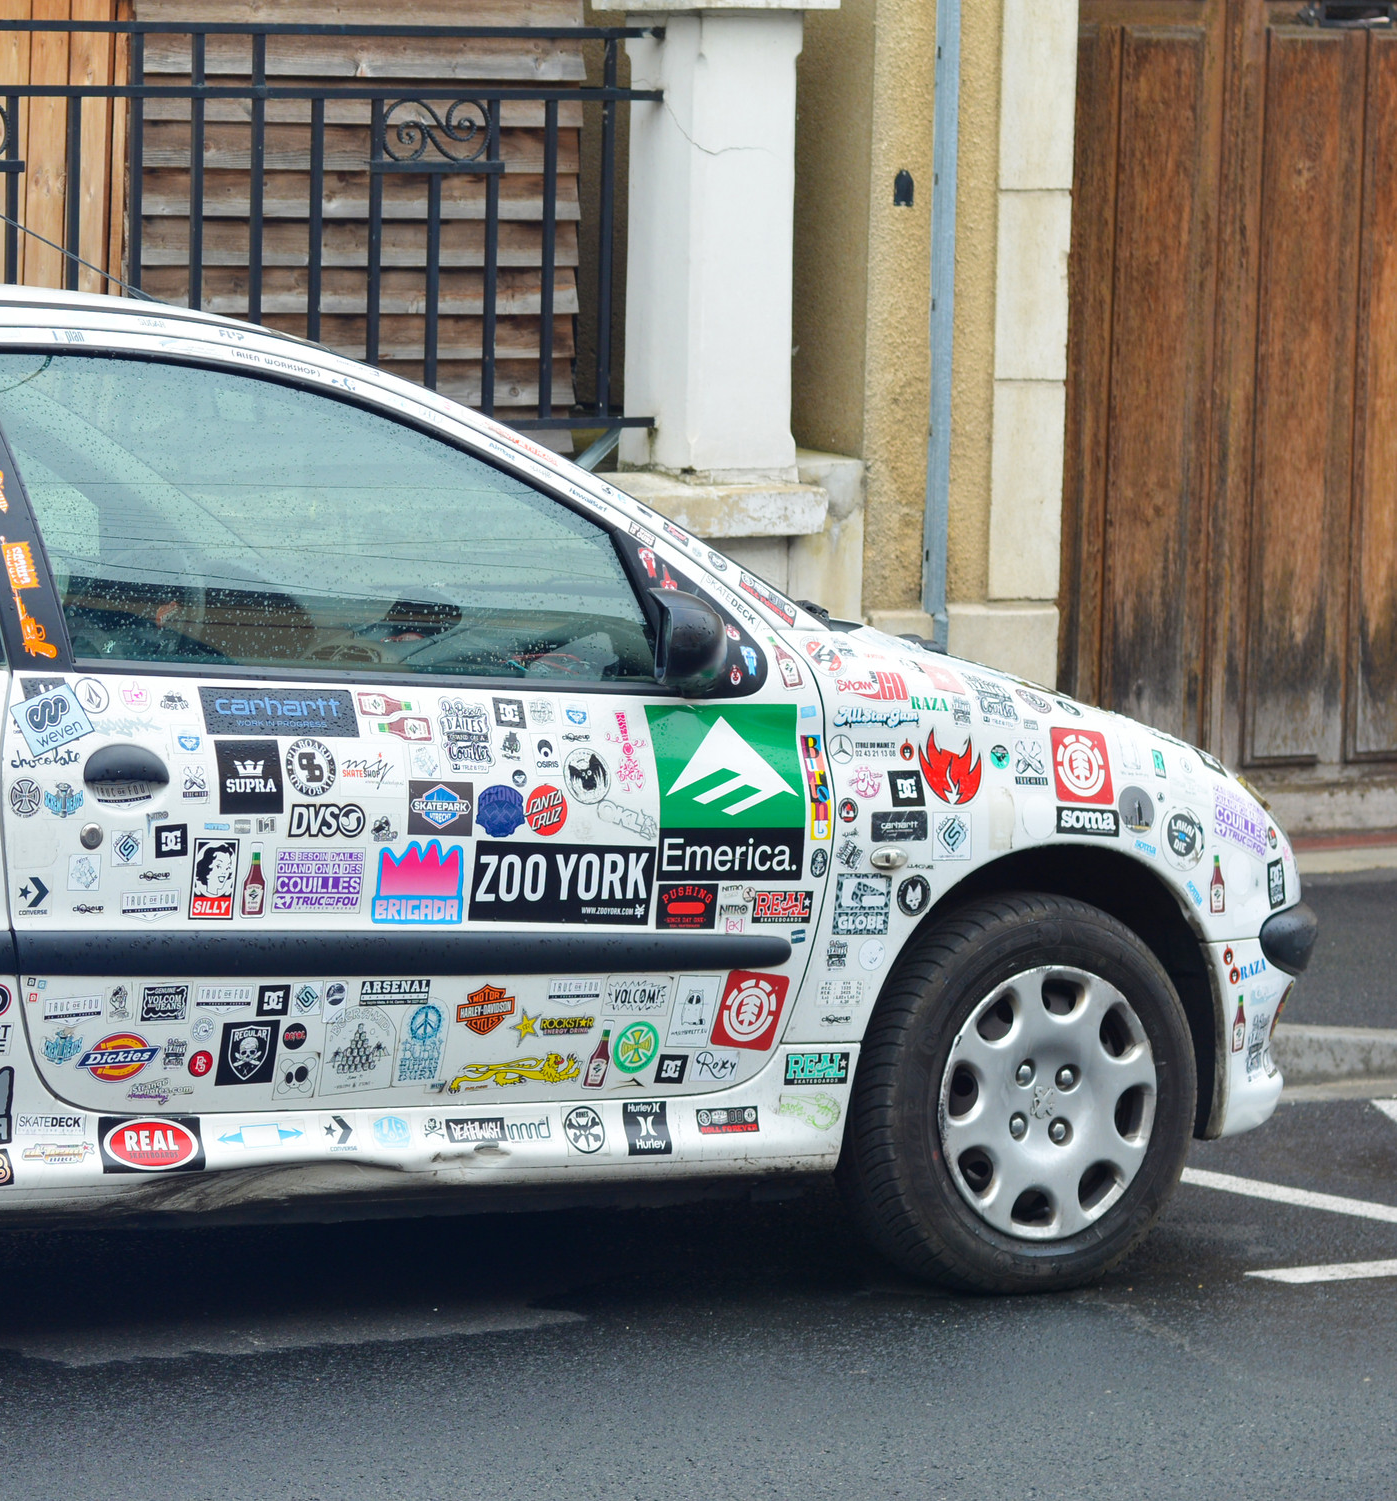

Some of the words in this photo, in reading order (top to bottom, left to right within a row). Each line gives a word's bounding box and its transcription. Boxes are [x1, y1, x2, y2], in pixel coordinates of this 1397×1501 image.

[215, 696, 340, 717] carhartt
[276, 720, 327, 729] PROGRESS
[446, 718, 483, 733] D'AILES
[37, 719, 84, 748] weven
[11, 747, 81, 769] chocolate
[287, 740, 332, 760] PIXBOARD
[536, 760, 559, 769] OSIRIS
[226, 777, 277, 794] SUPRA
[413, 801, 468, 812] SKATEPARK
[524, 789, 563, 816] SANTA
[288, 804, 340, 837] DVS
[429, 812, 452, 822] UTRECHT
[531, 808, 561, 831] CRUZ
[881, 820, 919, 830] carhartt
[1060, 809, 1116, 830] soma
[1215, 805, 1267, 845] COUILLES
[1171, 819, 1194, 837] LAKAI
[1135, 839, 1157, 857] soma
[1173, 836, 1187, 853] DIE
[1227, 829, 1246, 845] TRUC
[1252, 841, 1265, 857] FOU
[278, 852, 296, 861] PAS
[298, 852, 328, 861] BESOIN
[330, 852, 363, 861] D'AILES
[661, 837, 797, 872] Emerica.
[277, 864, 313, 874] QUAND
[315, 864, 329, 874] ON
[332, 864, 339, 874] A
[342, 864, 362, 874] DES
[476, 854, 548, 902] ZOO
[555, 852, 649, 900] YORK
[276, 876, 360, 893] COUILLES
[295, 896, 324, 907] TRUC
[325, 898, 334, 906] DE
[335, 896, 358, 906] FOU
[662, 885, 713, 904] PUSHING
[193, 900, 229, 915] SILLY
[375, 899, 458, 921] BRIGADA
[581, 906, 634, 915] WWW.ZOOYORK.COM
[837, 915, 886, 930] GLOBE
[361, 980, 429, 993] ARSENAL
[147, 995, 182, 1003] VOLCOM
[471, 990, 500, 1002] MOTOR
[615, 988, 661, 1003] VOLCOM!
[155, 1002, 183, 1010] JEANS
[459, 999, 512, 1018] HARLEY-DAVIDSON
[470, 1016, 503, 1032] CYCLES
[233, 1029, 268, 1042] REGULAR
[86, 1050, 152, 1065] Dickies
[627, 1103, 652, 1113] Hurley
[18, 1115, 81, 1128] SKATEDECK
[450, 1121, 502, 1140] DEATHWISH
[124, 1130, 180, 1152] REAL
[636, 1137, 666, 1150] Hurley
